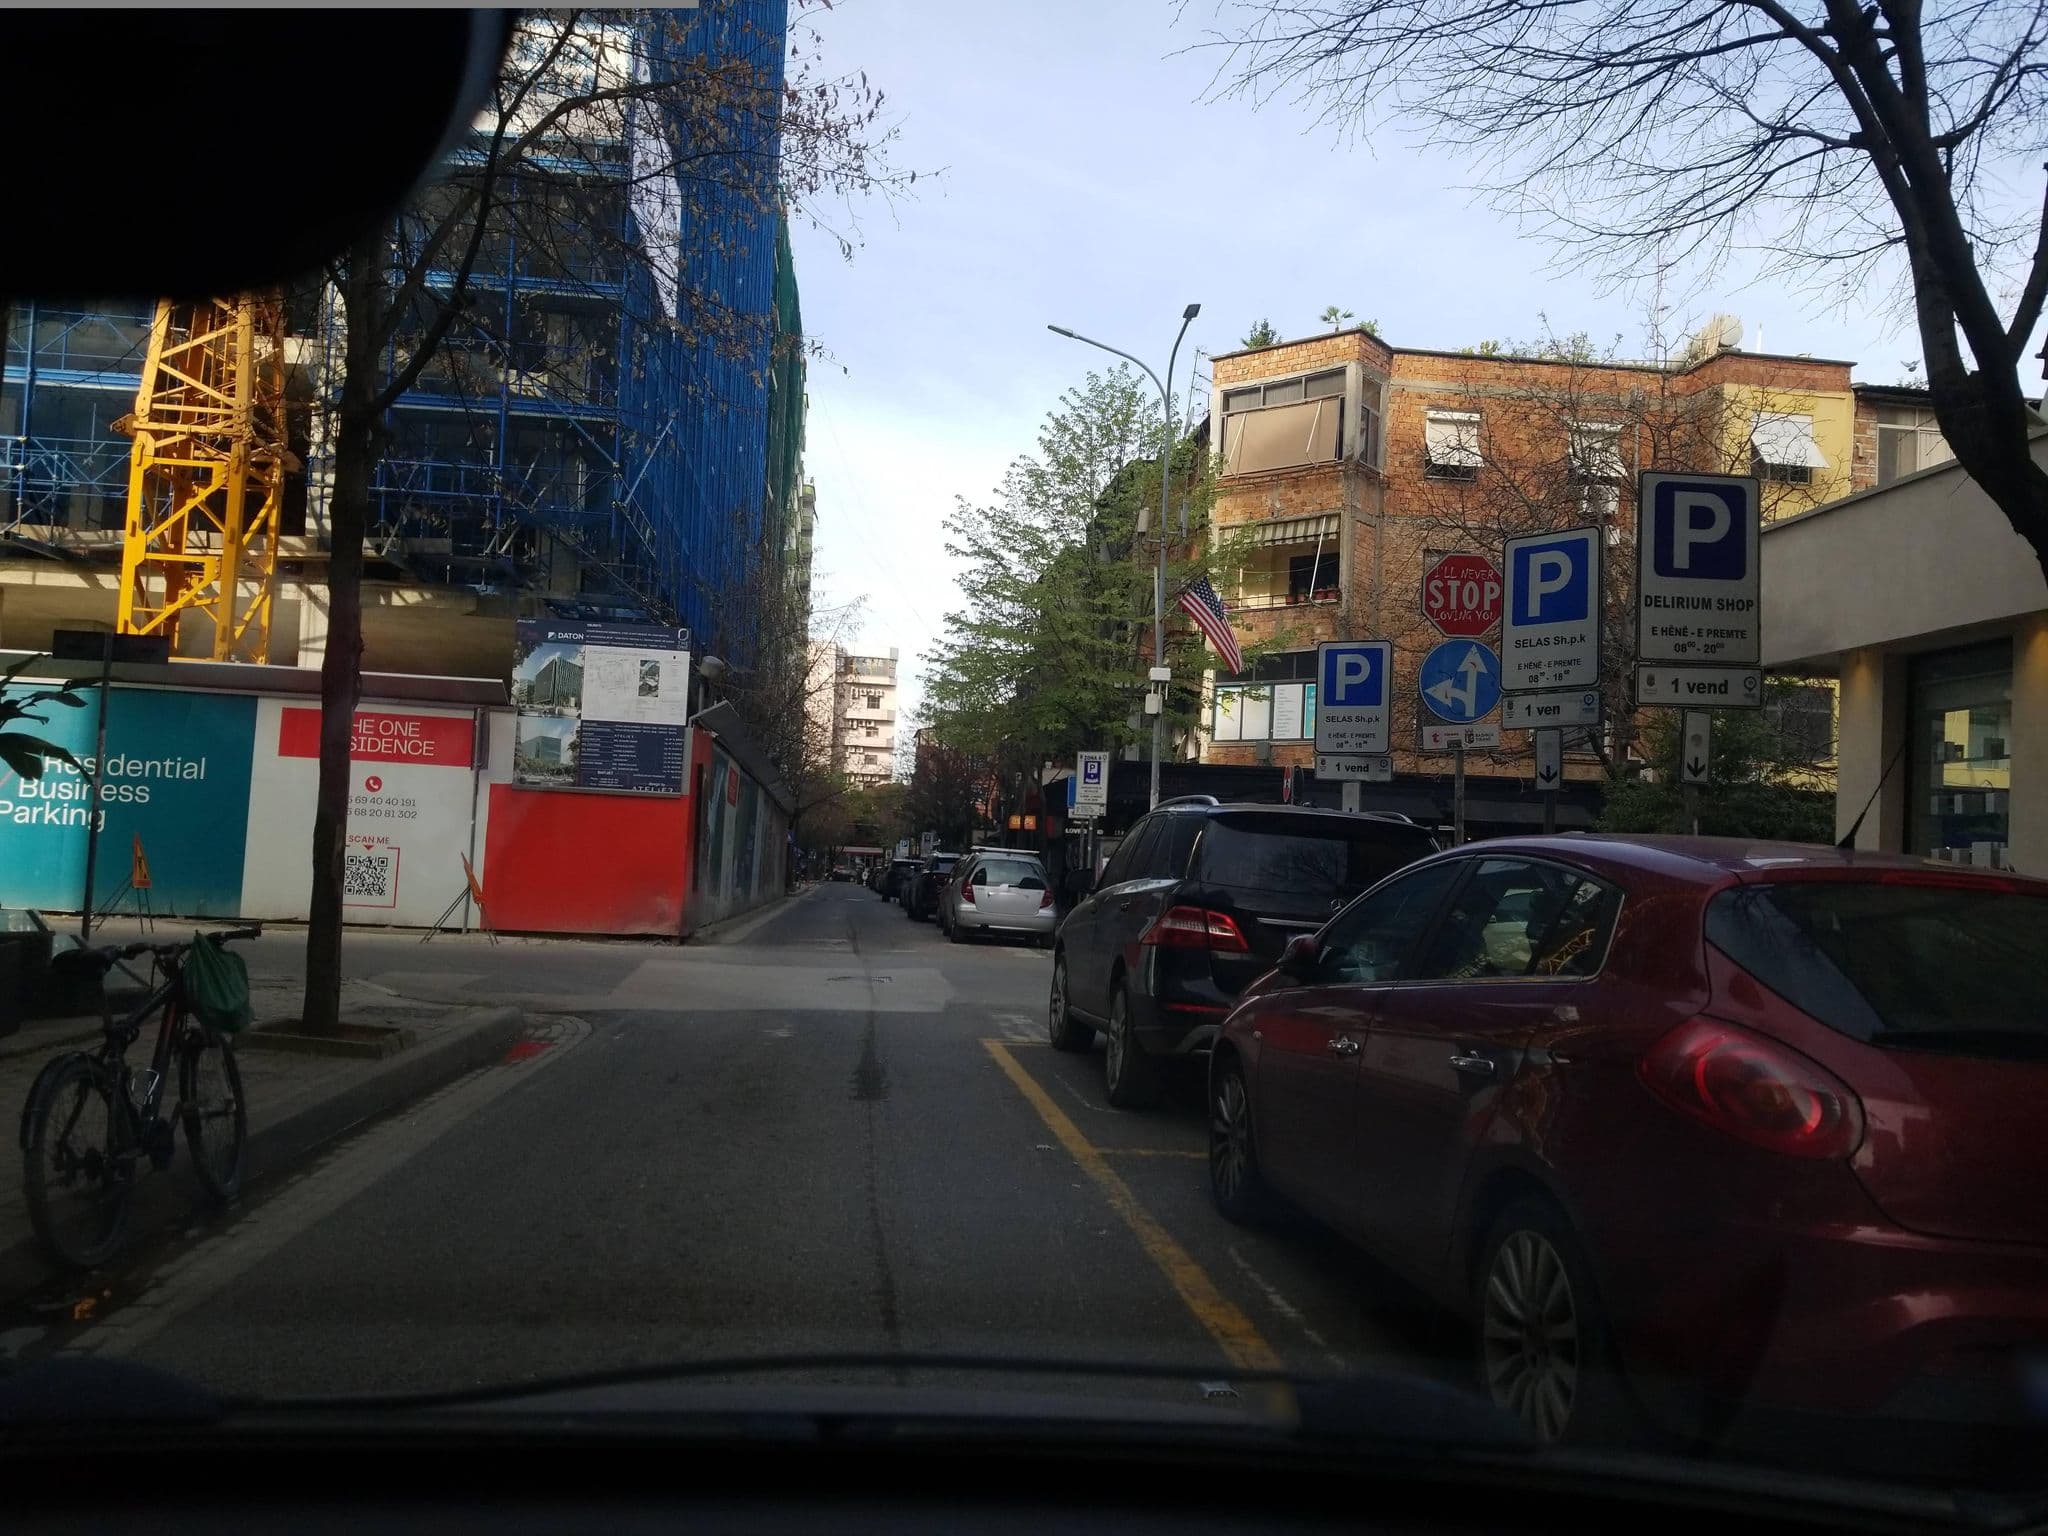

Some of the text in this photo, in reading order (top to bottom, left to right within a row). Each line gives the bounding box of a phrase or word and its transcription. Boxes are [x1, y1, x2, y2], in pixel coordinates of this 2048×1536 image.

[1672, 490, 1732, 569] P
[1434, 566, 1495, 580] I'LL NEVER
[1527, 550, 1573, 618] P
[1429, 580, 1501, 610] STOP
[1644, 594, 1754, 612] DELIRIUM SHOP
[1433, 609, 1497, 621] LOVING YOU
[558, 631, 585, 640] DATON
[1651, 626, 1658, 636] E
[1697, 628, 1704, 637] E
[1706, 628, 1748, 639] PREMTE
[1514, 634, 1586, 648] SELAS Sh.p.k
[1553, 658, 1582, 667] PREMTE
[1335, 654, 1371, 700] P
[1671, 677, 1729, 695] 1 vend
[1525, 704, 1531, 717] 1
[1325, 715, 1353, 723] SELAS
[379, 720, 421, 737] ONE
[1335, 762, 1341, 772] 1
[1344, 763, 1369, 772] vend
[355, 796, 368, 804] 69
[369, 797, 383, 805] 40
[385, 798, 399, 806] 40
[401, 798, 416, 807] 191
[354, 808, 367, 816] 68
[369, 809, 382, 817] 20
[384, 809, 396, 818] 81
[348, 835, 390, 844] SCAN ME
